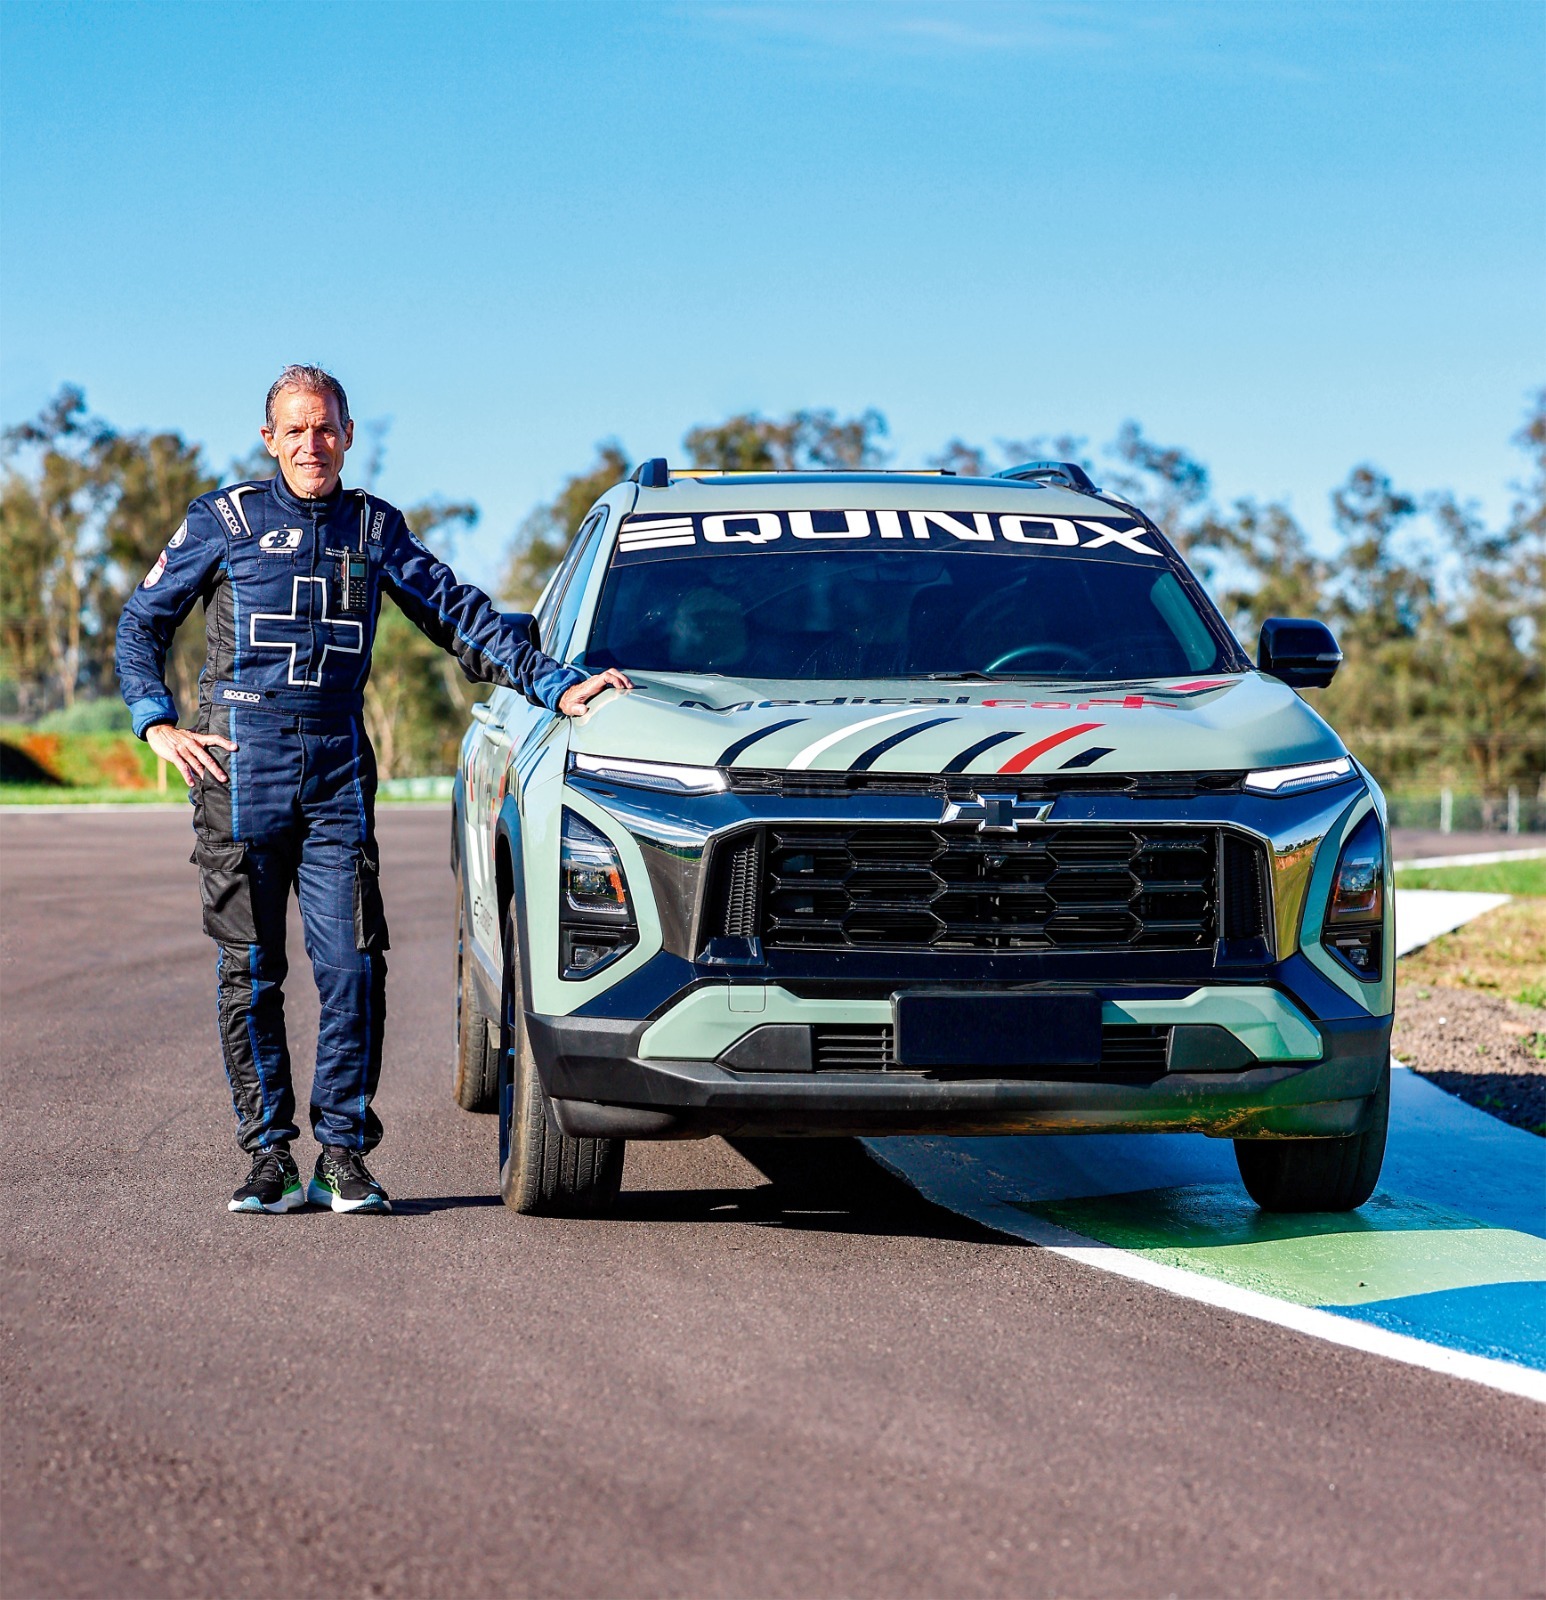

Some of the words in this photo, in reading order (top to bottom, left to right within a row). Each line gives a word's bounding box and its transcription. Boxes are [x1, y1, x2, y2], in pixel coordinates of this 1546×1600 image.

[215, 497, 241, 535] sparco
[619, 511, 1163, 557] EQUINOX
[223, 689, 260, 703] sparco
